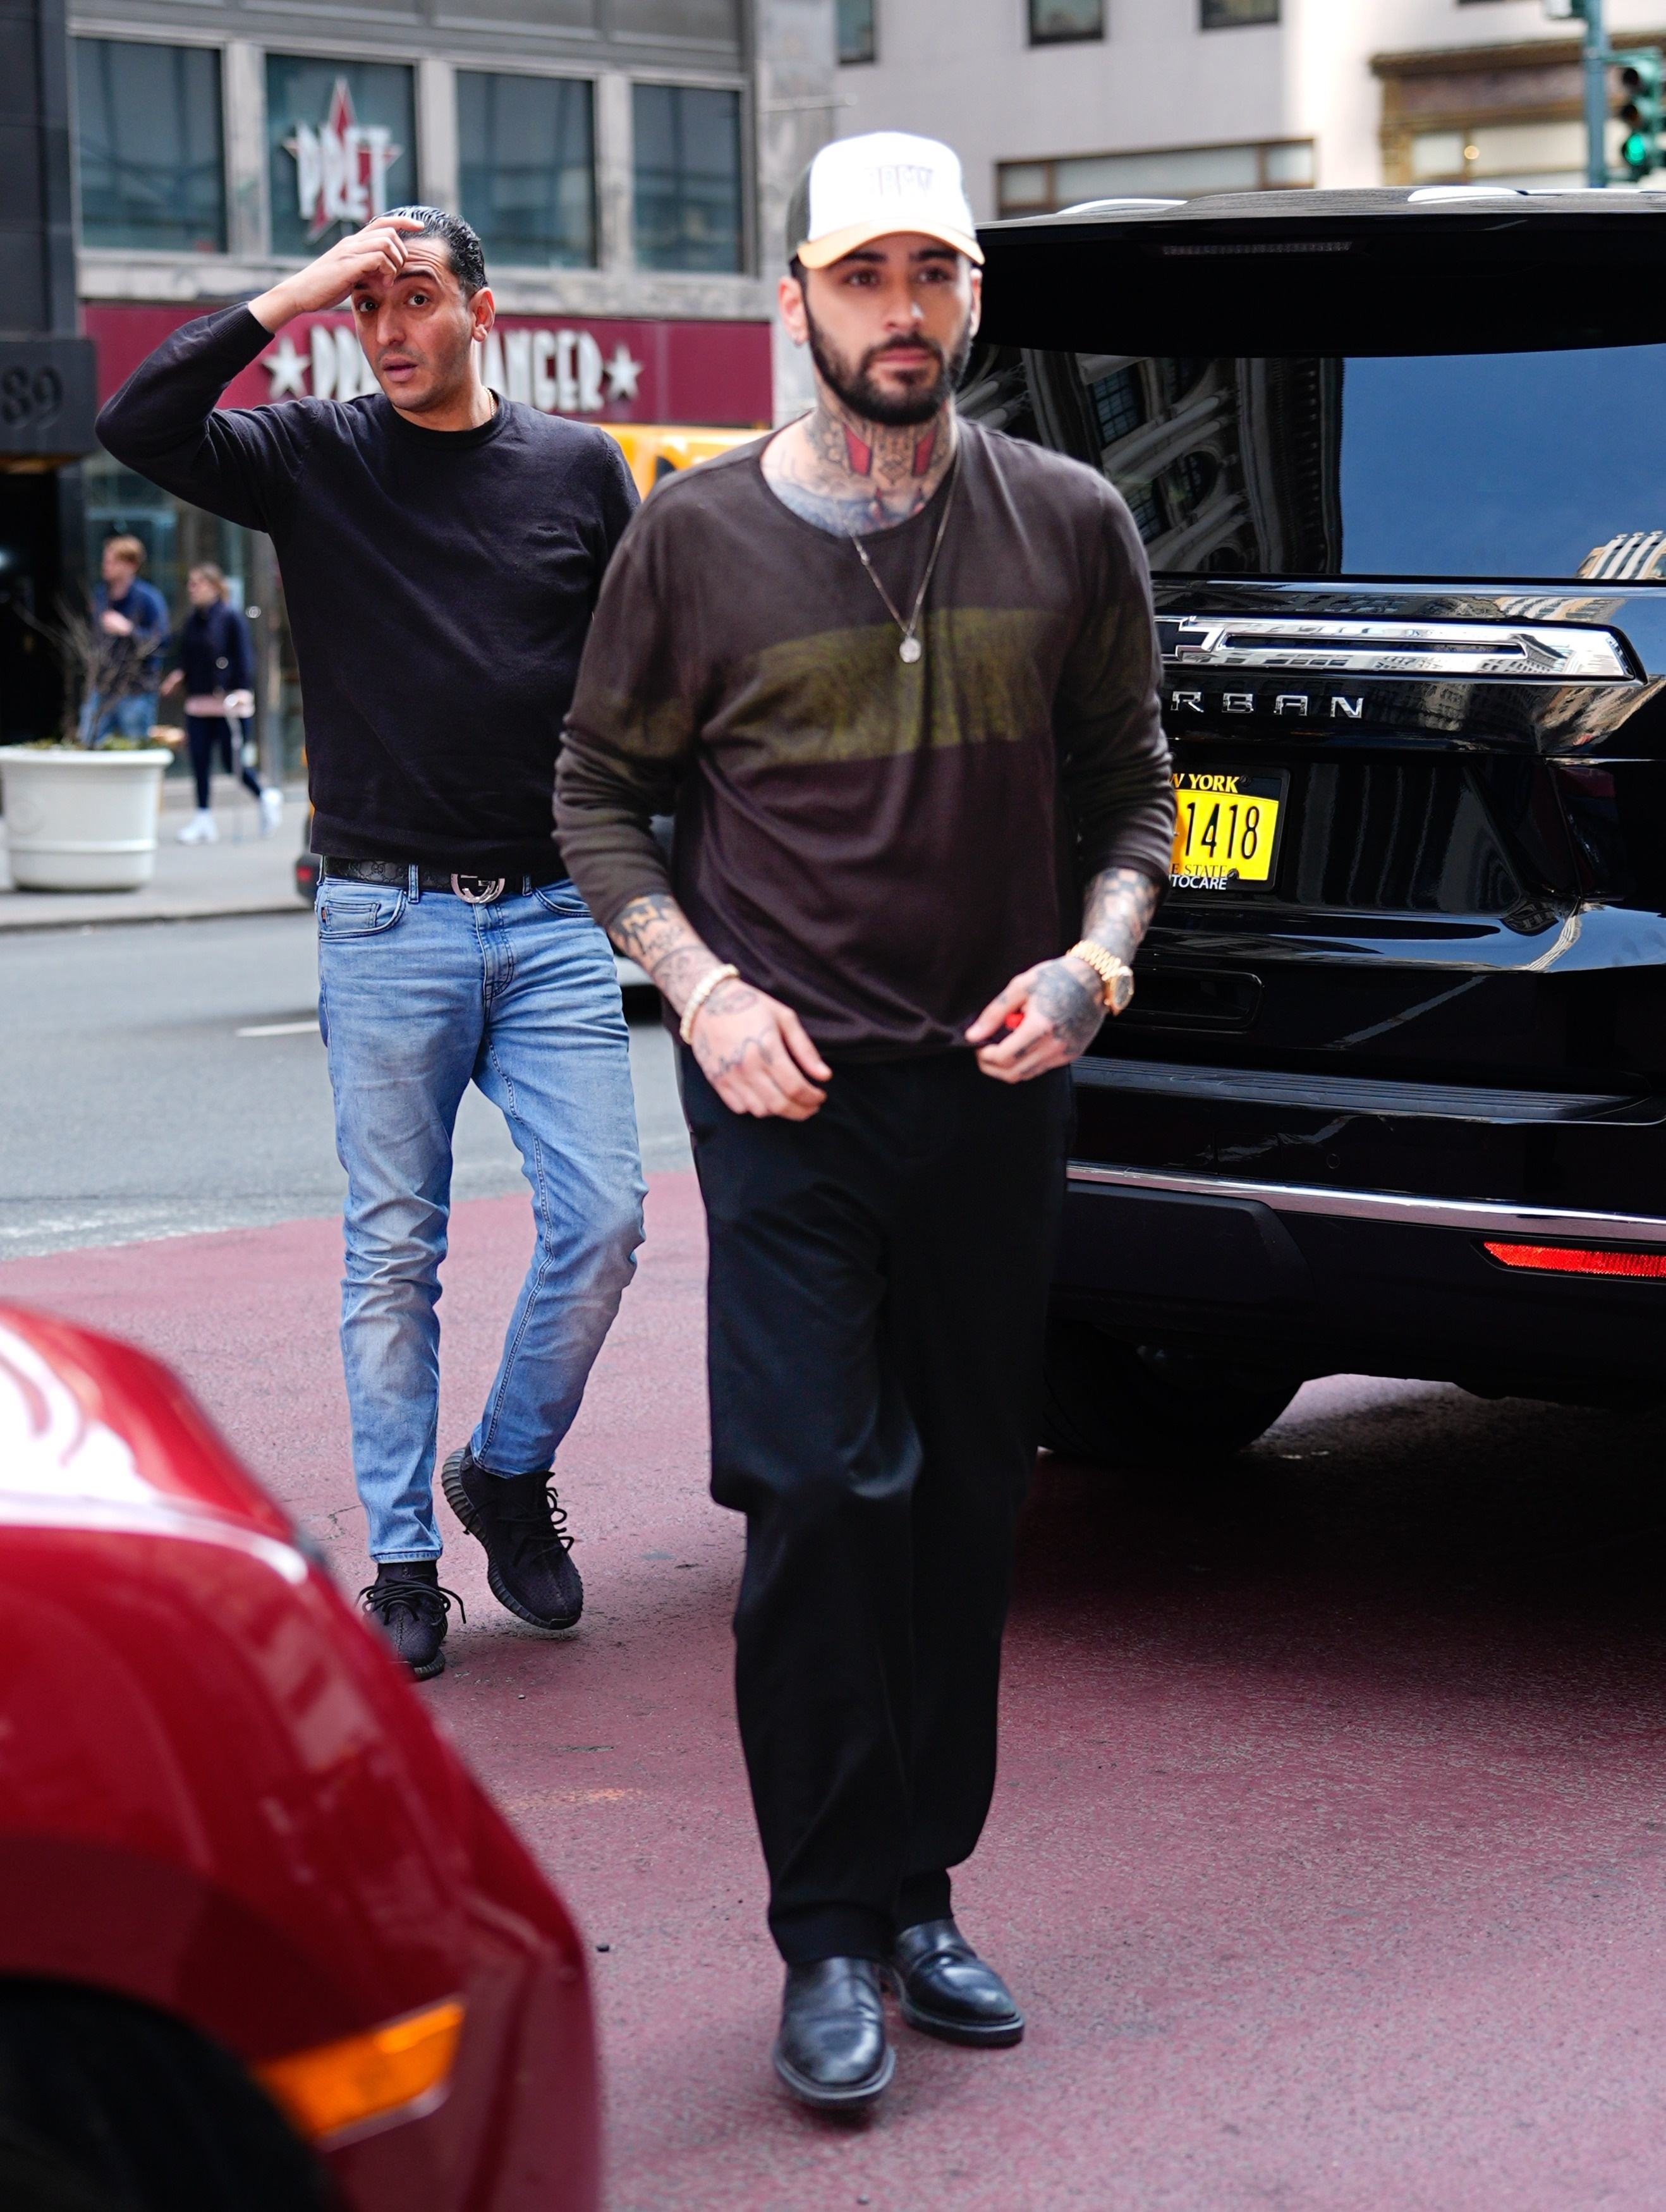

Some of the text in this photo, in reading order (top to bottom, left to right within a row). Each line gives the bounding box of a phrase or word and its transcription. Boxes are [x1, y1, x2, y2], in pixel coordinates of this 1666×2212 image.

[294, 124, 391, 219] PRET
[1170, 691, 1365, 719] RBAN
[1188, 773, 1240, 794] YORK
[1185, 802, 1260, 860] 1418
[1169, 875, 1229, 890] TOCARE
[1183, 863, 1228, 879] STATE
